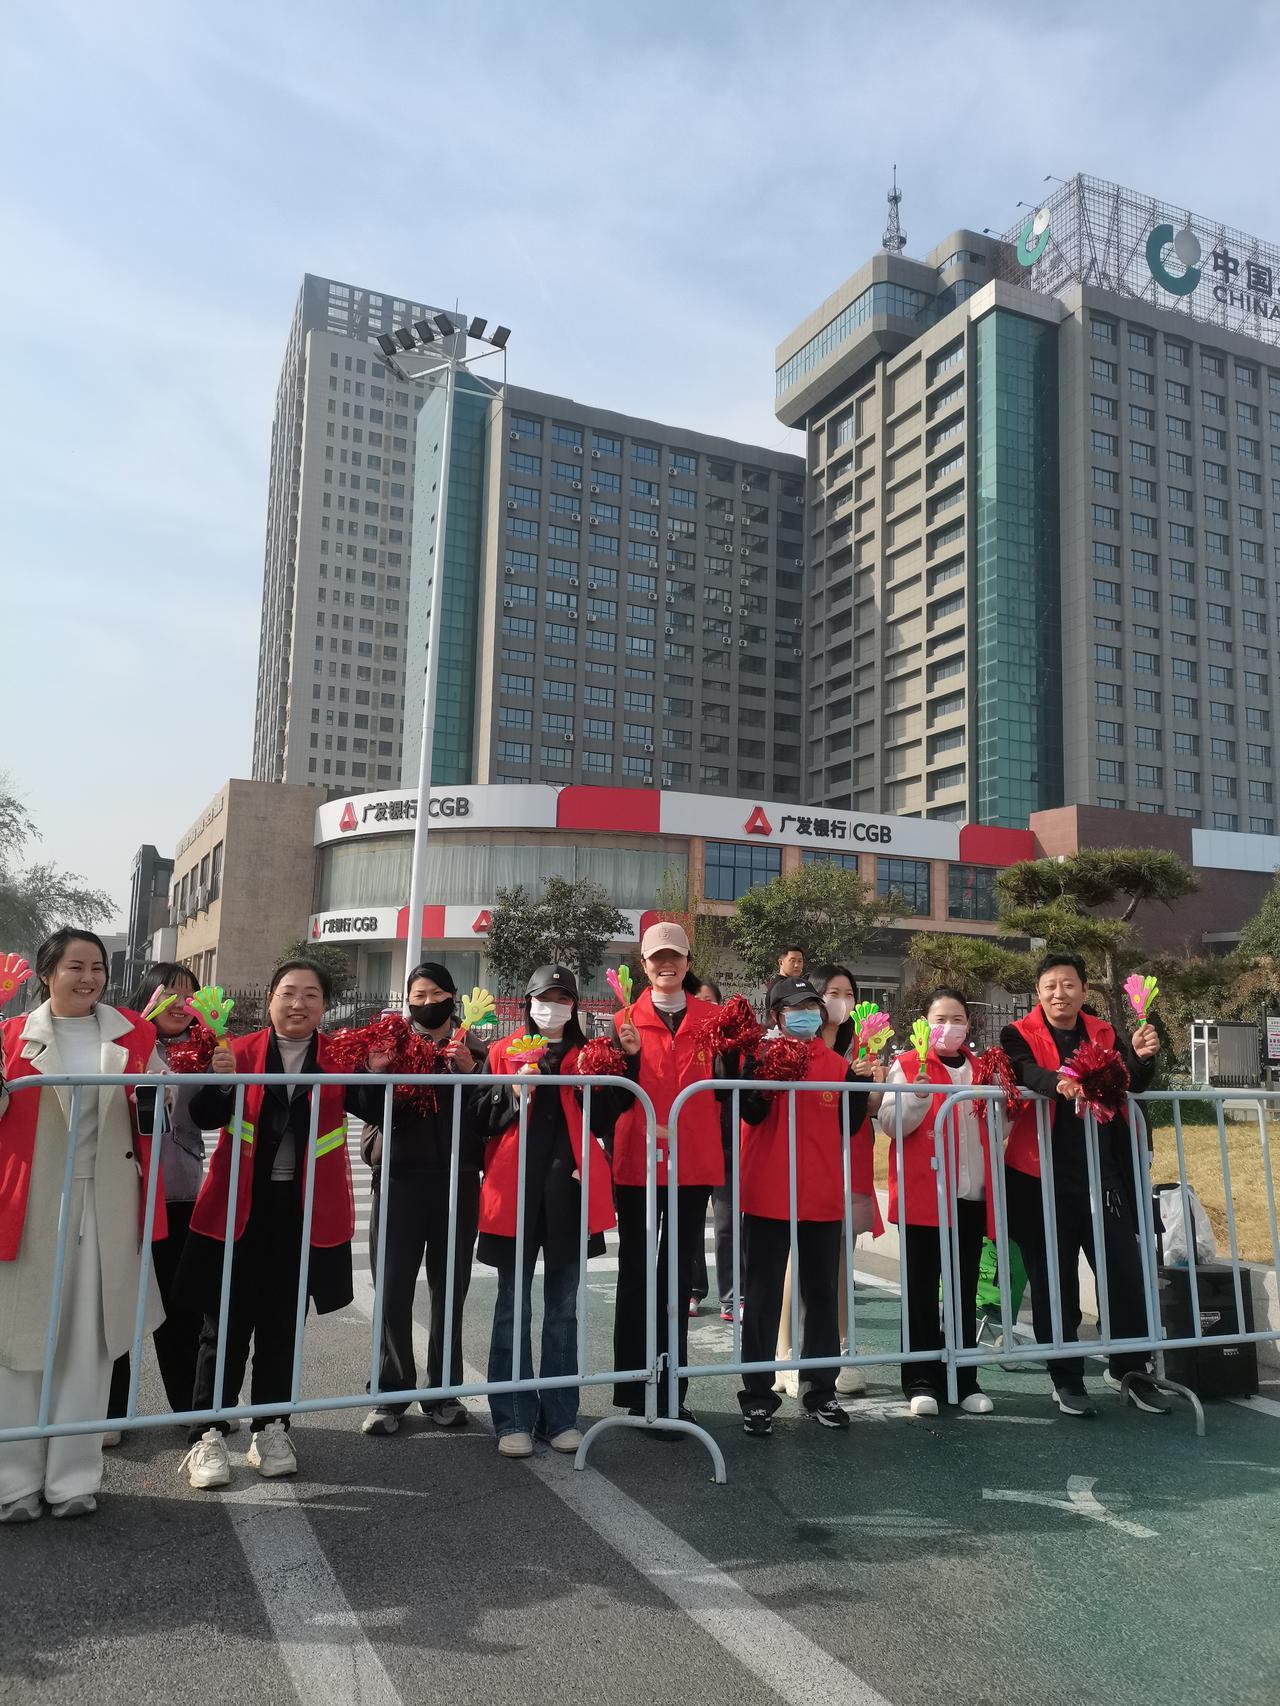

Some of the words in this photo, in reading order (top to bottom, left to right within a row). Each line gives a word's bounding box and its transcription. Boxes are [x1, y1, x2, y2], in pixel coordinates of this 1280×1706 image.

[1211, 249, 1280, 297] 中国
[362, 799, 418, 823] 广发银行
[428, 797, 469, 817] CGB
[779, 815, 846, 839] 广发银行
[853, 823, 892, 844] CGB
[354, 916, 378, 932] CGB
